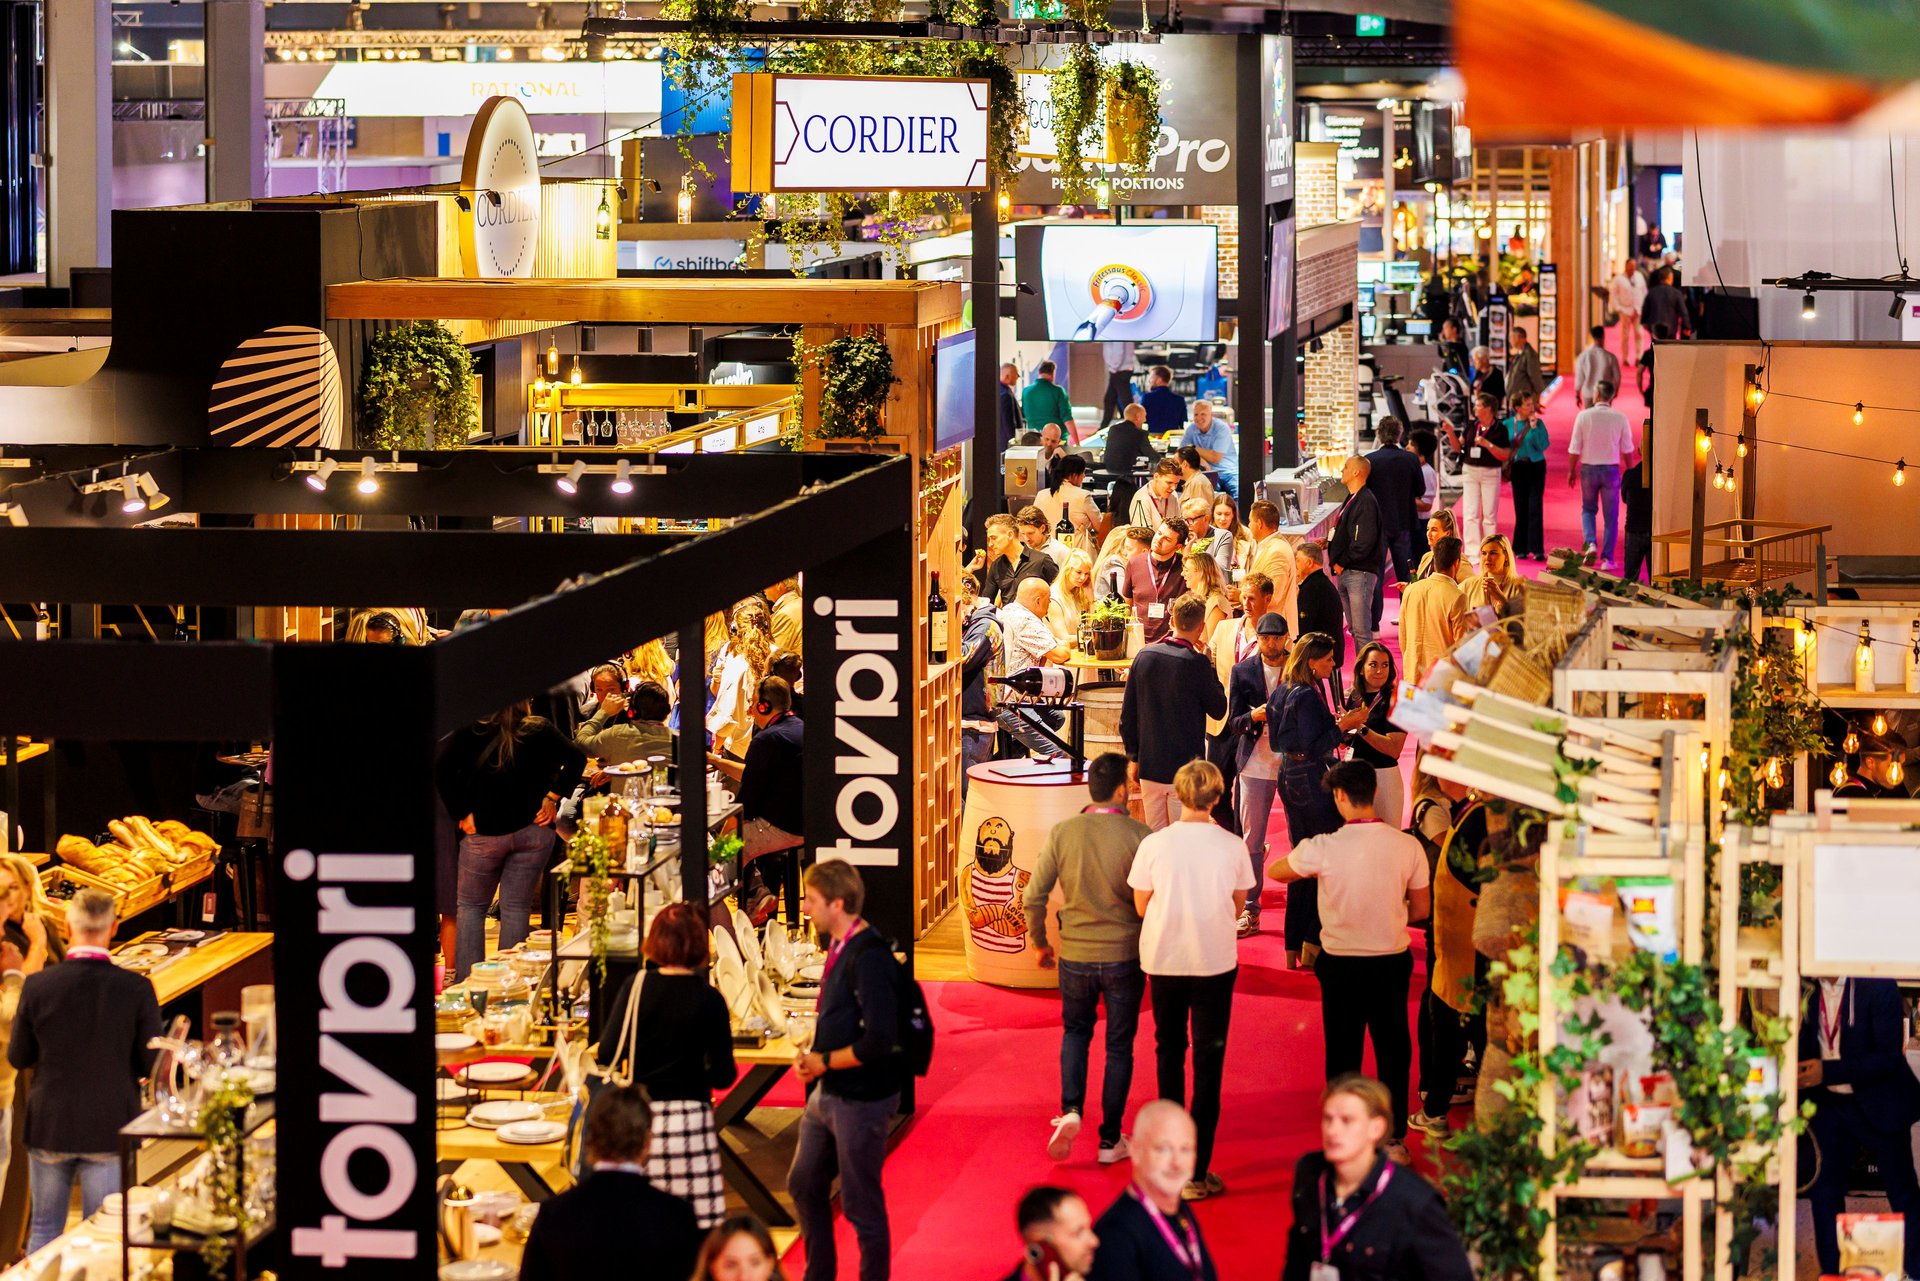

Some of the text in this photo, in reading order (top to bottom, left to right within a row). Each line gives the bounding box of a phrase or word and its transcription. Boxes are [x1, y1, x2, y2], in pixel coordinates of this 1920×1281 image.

[471, 81, 581, 97] RATIONAL
[803, 114, 960, 154] CORDIER
[1112, 177, 1185, 190] PORTIONS
[476, 188, 538, 228] CORDIER
[1092, 267, 1147, 293] Fritessaus Classic
[813, 595, 899, 867] tovpri
[283, 848, 418, 1268] tovpri
